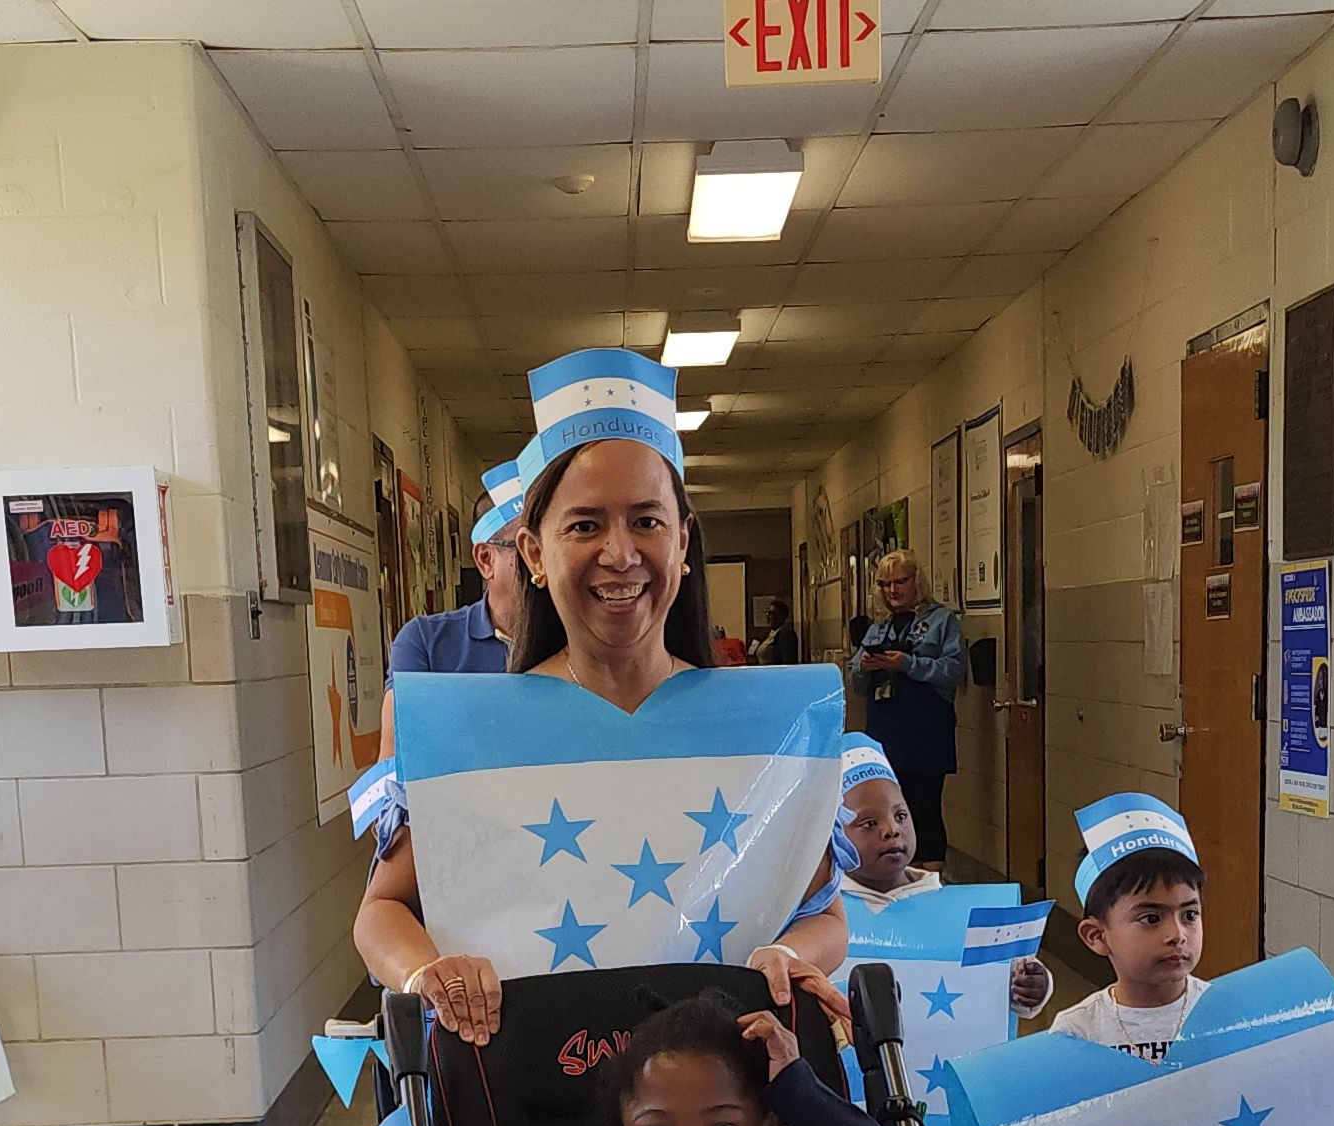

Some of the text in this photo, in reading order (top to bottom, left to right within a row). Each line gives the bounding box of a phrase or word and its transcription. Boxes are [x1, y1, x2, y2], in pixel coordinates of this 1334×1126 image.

[754, 0, 851, 72] EXIT
[561, 416, 664, 447] Honduras
[50, 520, 91, 539] AED
